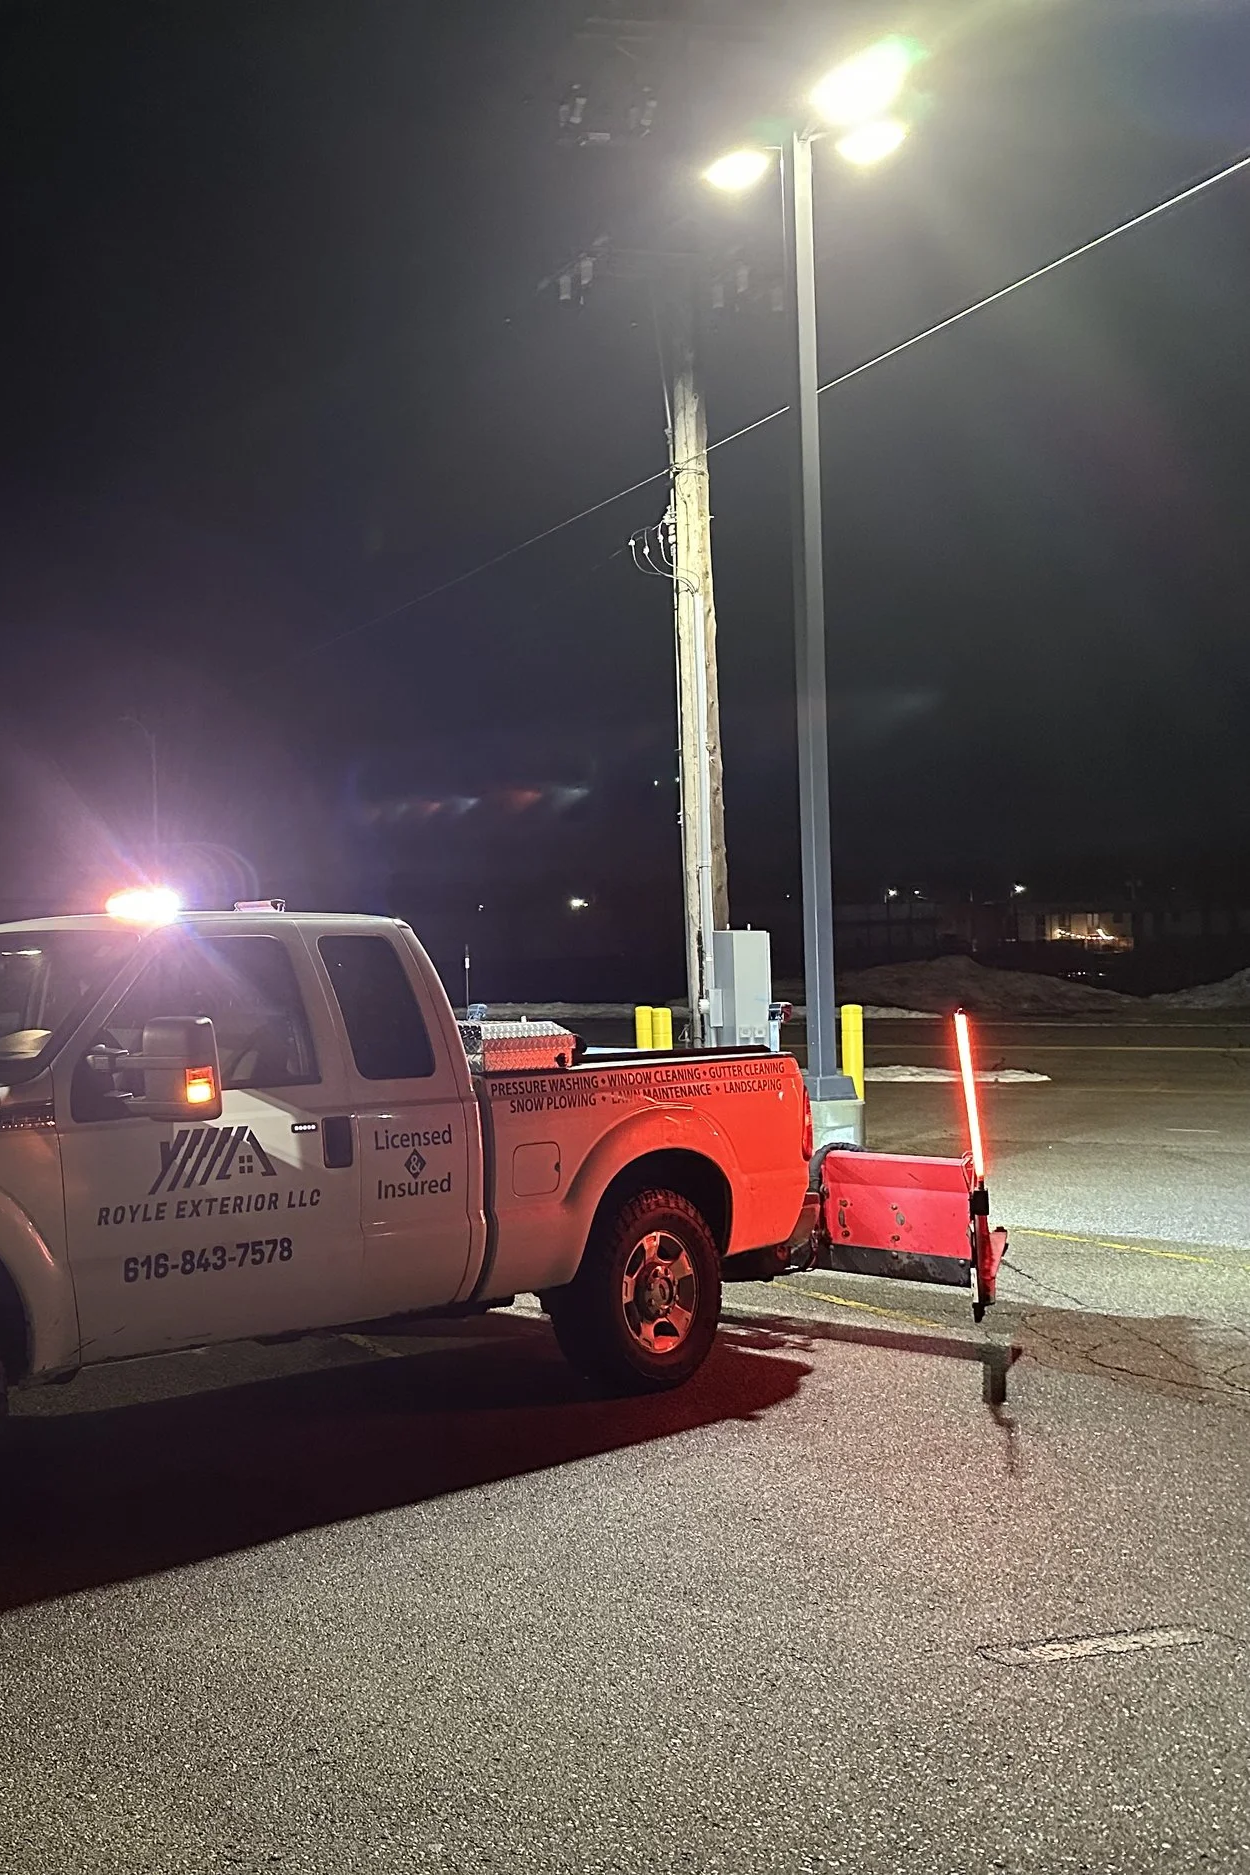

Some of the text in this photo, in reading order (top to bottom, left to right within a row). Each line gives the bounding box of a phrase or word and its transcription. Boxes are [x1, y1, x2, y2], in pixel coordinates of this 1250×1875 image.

[491, 1062, 785, 1096] PRESSURE WASHING WINDOW CLEANING GUTTER CLEANING
[510, 1097, 544, 1113] SNOW
[547, 1093, 596, 1110] PLOWING
[643, 1084, 712, 1101] MAINTENANCE
[724, 1079, 782, 1094] LANDSCAPING
[374, 1123, 452, 1150] Licensed
[410, 1155, 421, 1173] &
[378, 1172, 451, 1199] Insured
[97, 1188, 321, 1226] ROYLE EXTERIOR LLC
[123, 1237, 293, 1283] 616-843-7578
